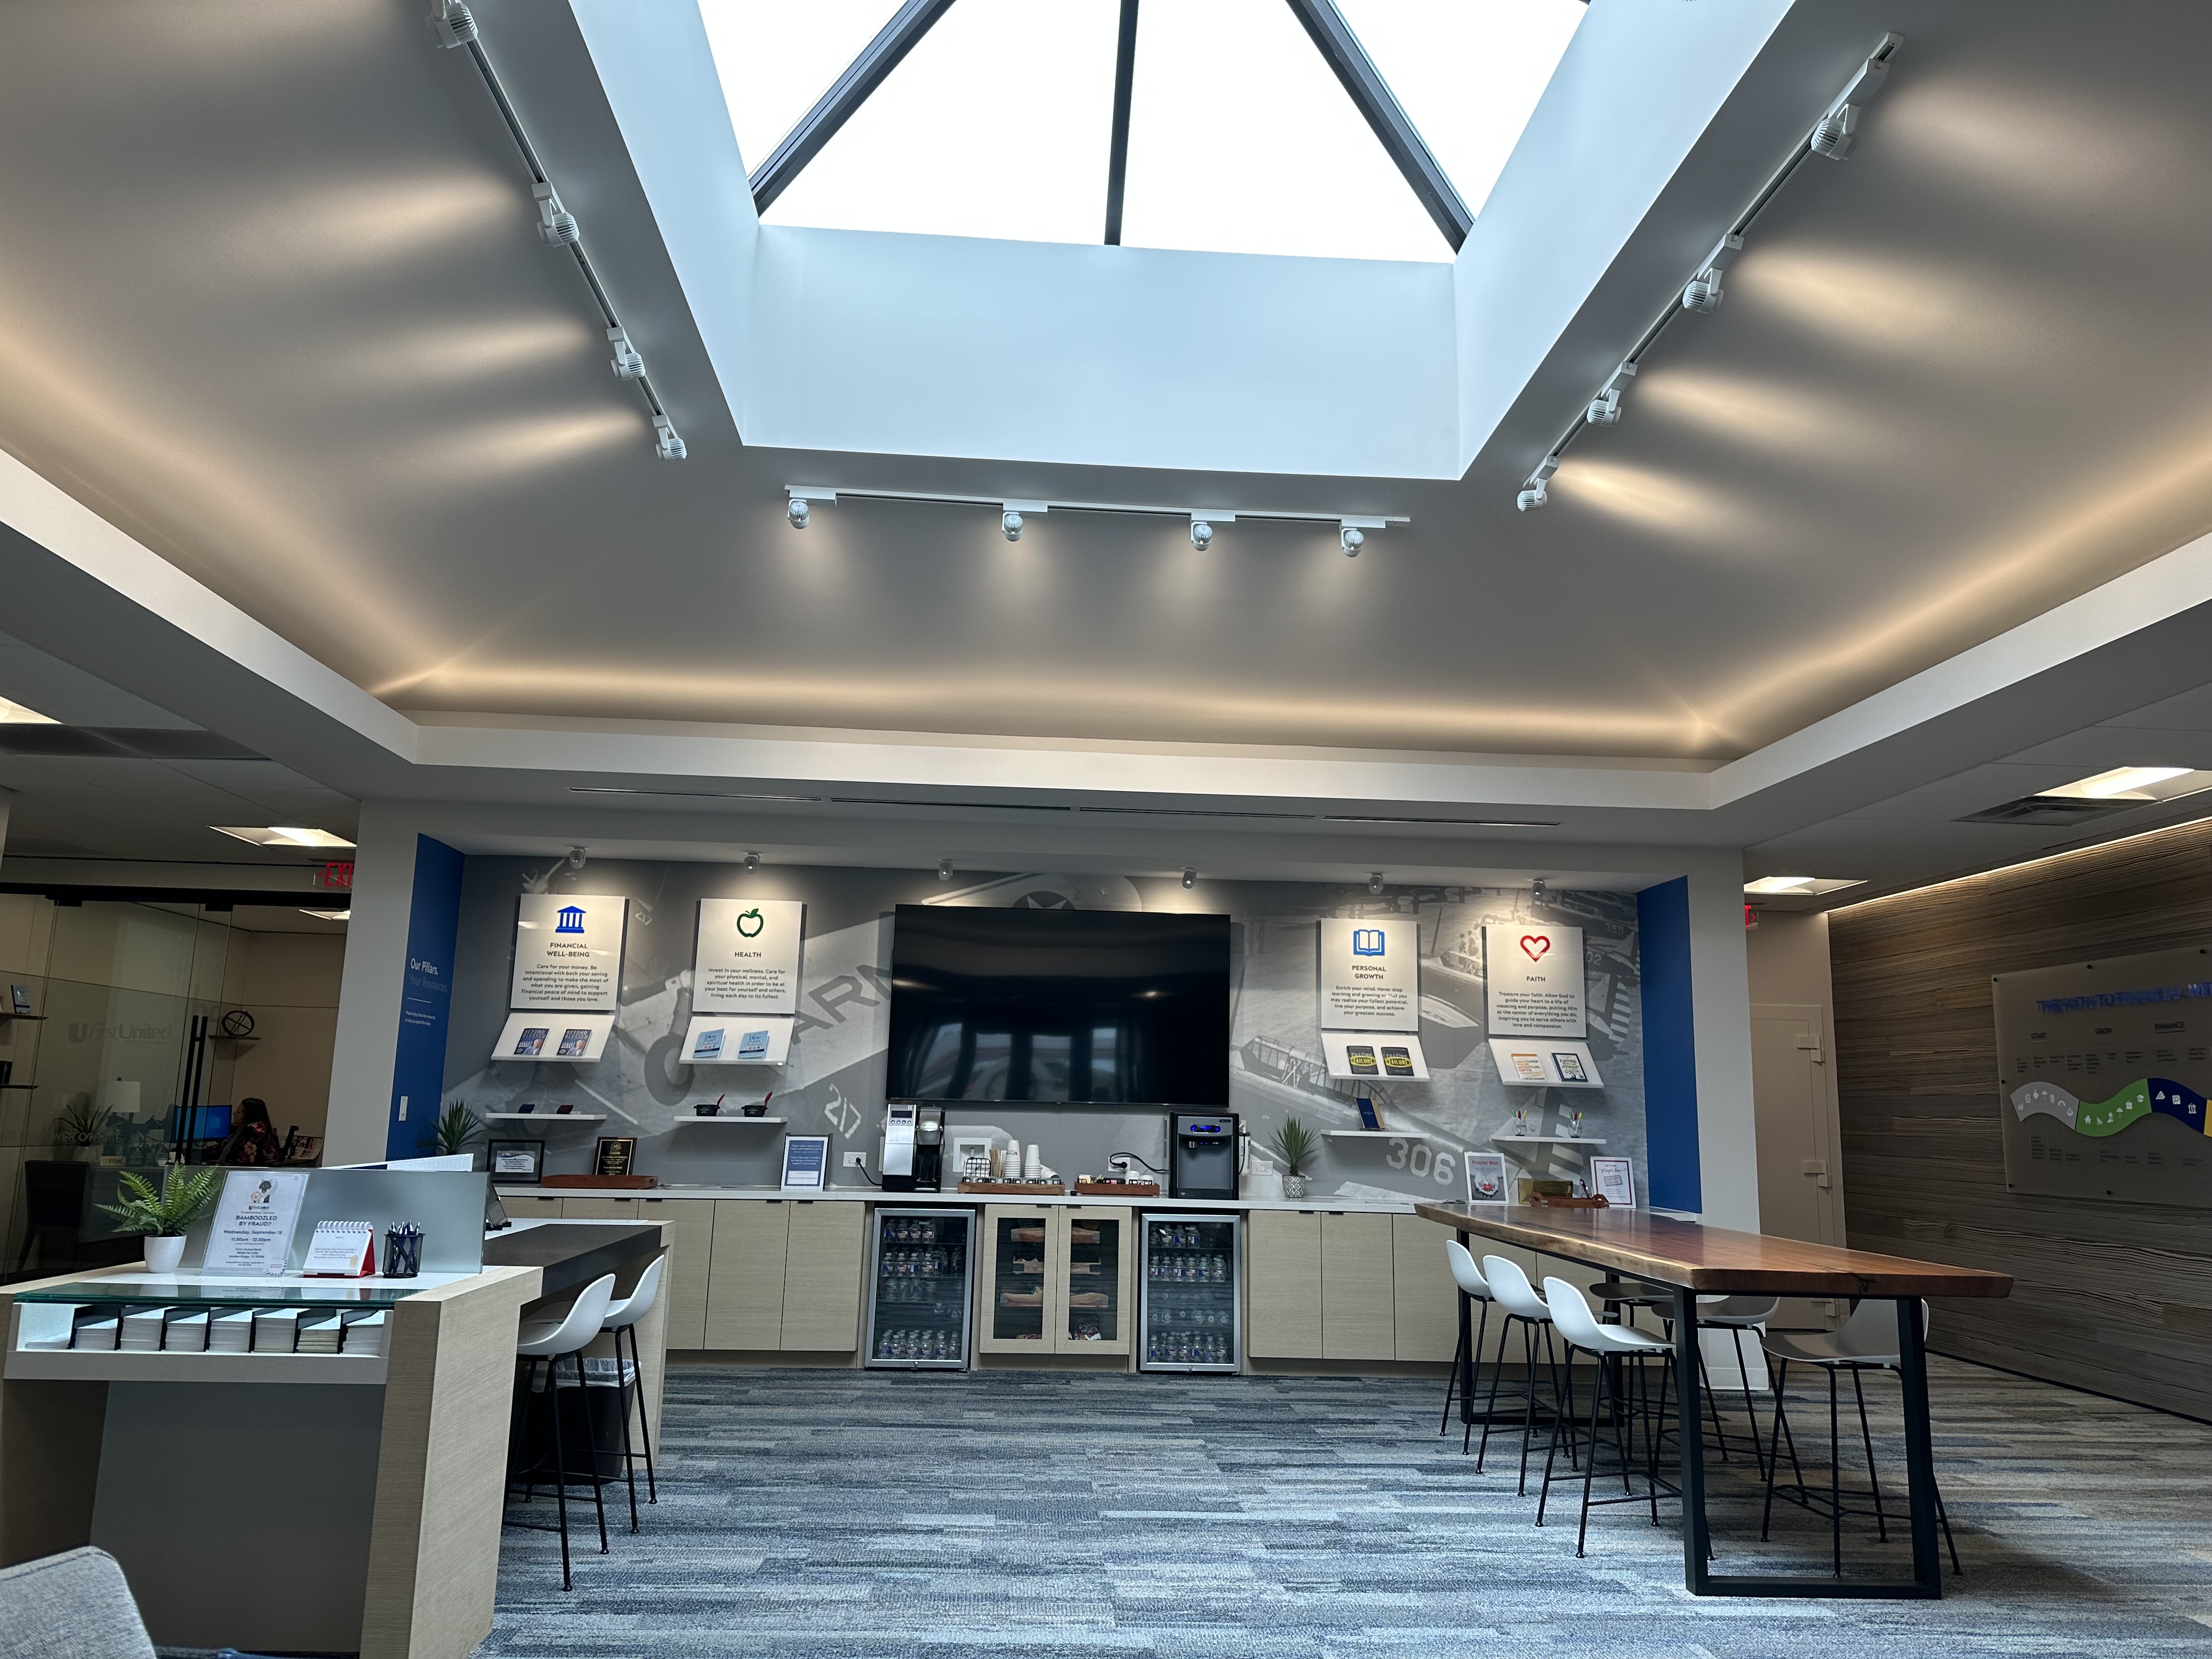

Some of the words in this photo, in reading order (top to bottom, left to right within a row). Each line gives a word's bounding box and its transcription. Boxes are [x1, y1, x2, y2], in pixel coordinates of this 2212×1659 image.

[1605, 923, 1624, 935] 355
[411, 958, 421, 970] Our
[422, 961, 438, 975] Pillars.
[409, 974, 422, 986] Your
[422, 977, 448, 992] Resources.
[2154, 1022, 2185, 1030] ENHANCE
[1386, 1138, 1455, 1186] 306
